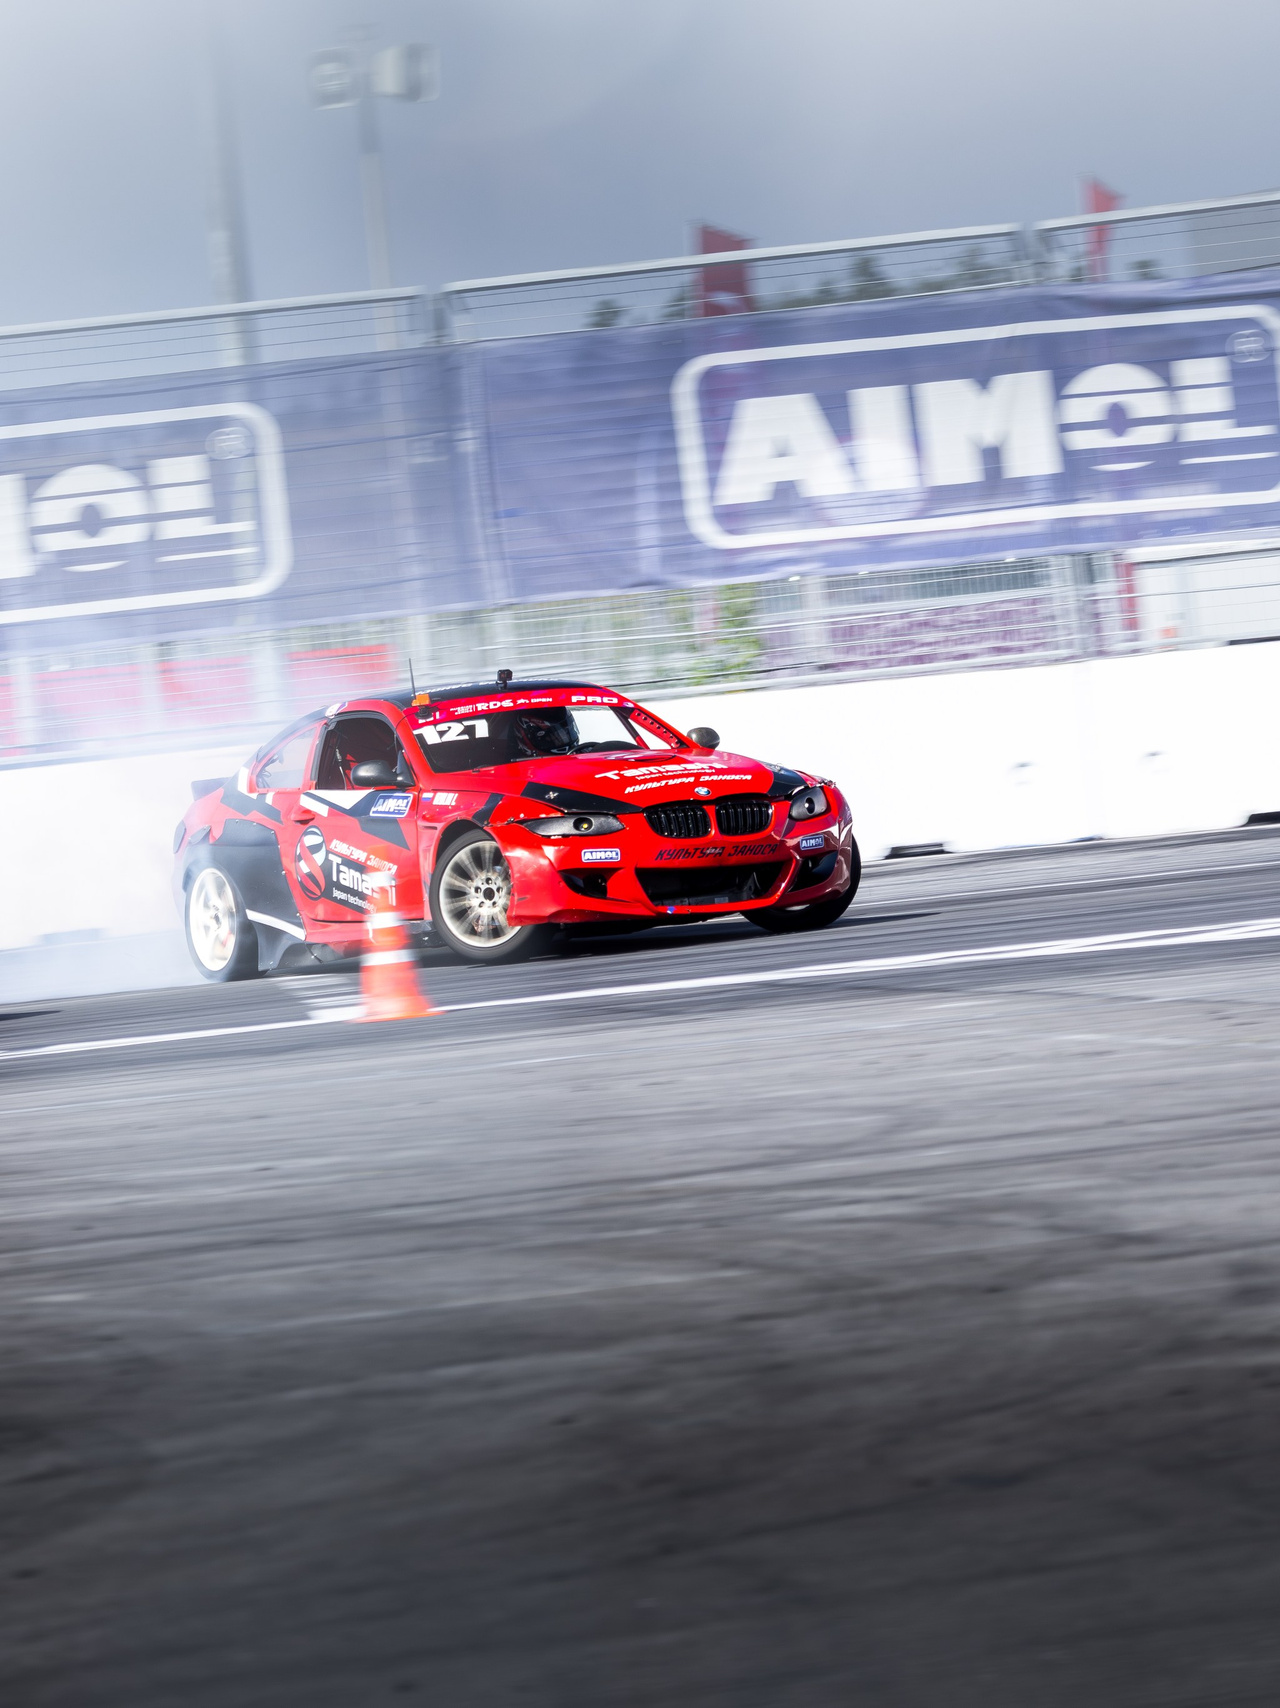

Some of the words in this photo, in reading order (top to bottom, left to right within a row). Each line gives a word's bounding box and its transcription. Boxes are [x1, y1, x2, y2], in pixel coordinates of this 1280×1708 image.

[713, 356, 1279, 505] AIMOL
[476, 699, 514, 711] RDS
[571, 695, 618, 704] PRO
[413, 718, 489, 745] 127
[624, 777, 695, 794] КУЛЬТУРА
[583, 850, 618, 860] AIMOL
[654, 845, 723, 860] КУЛЬТУРА
[730, 843, 779, 856] ЗАНОСА
